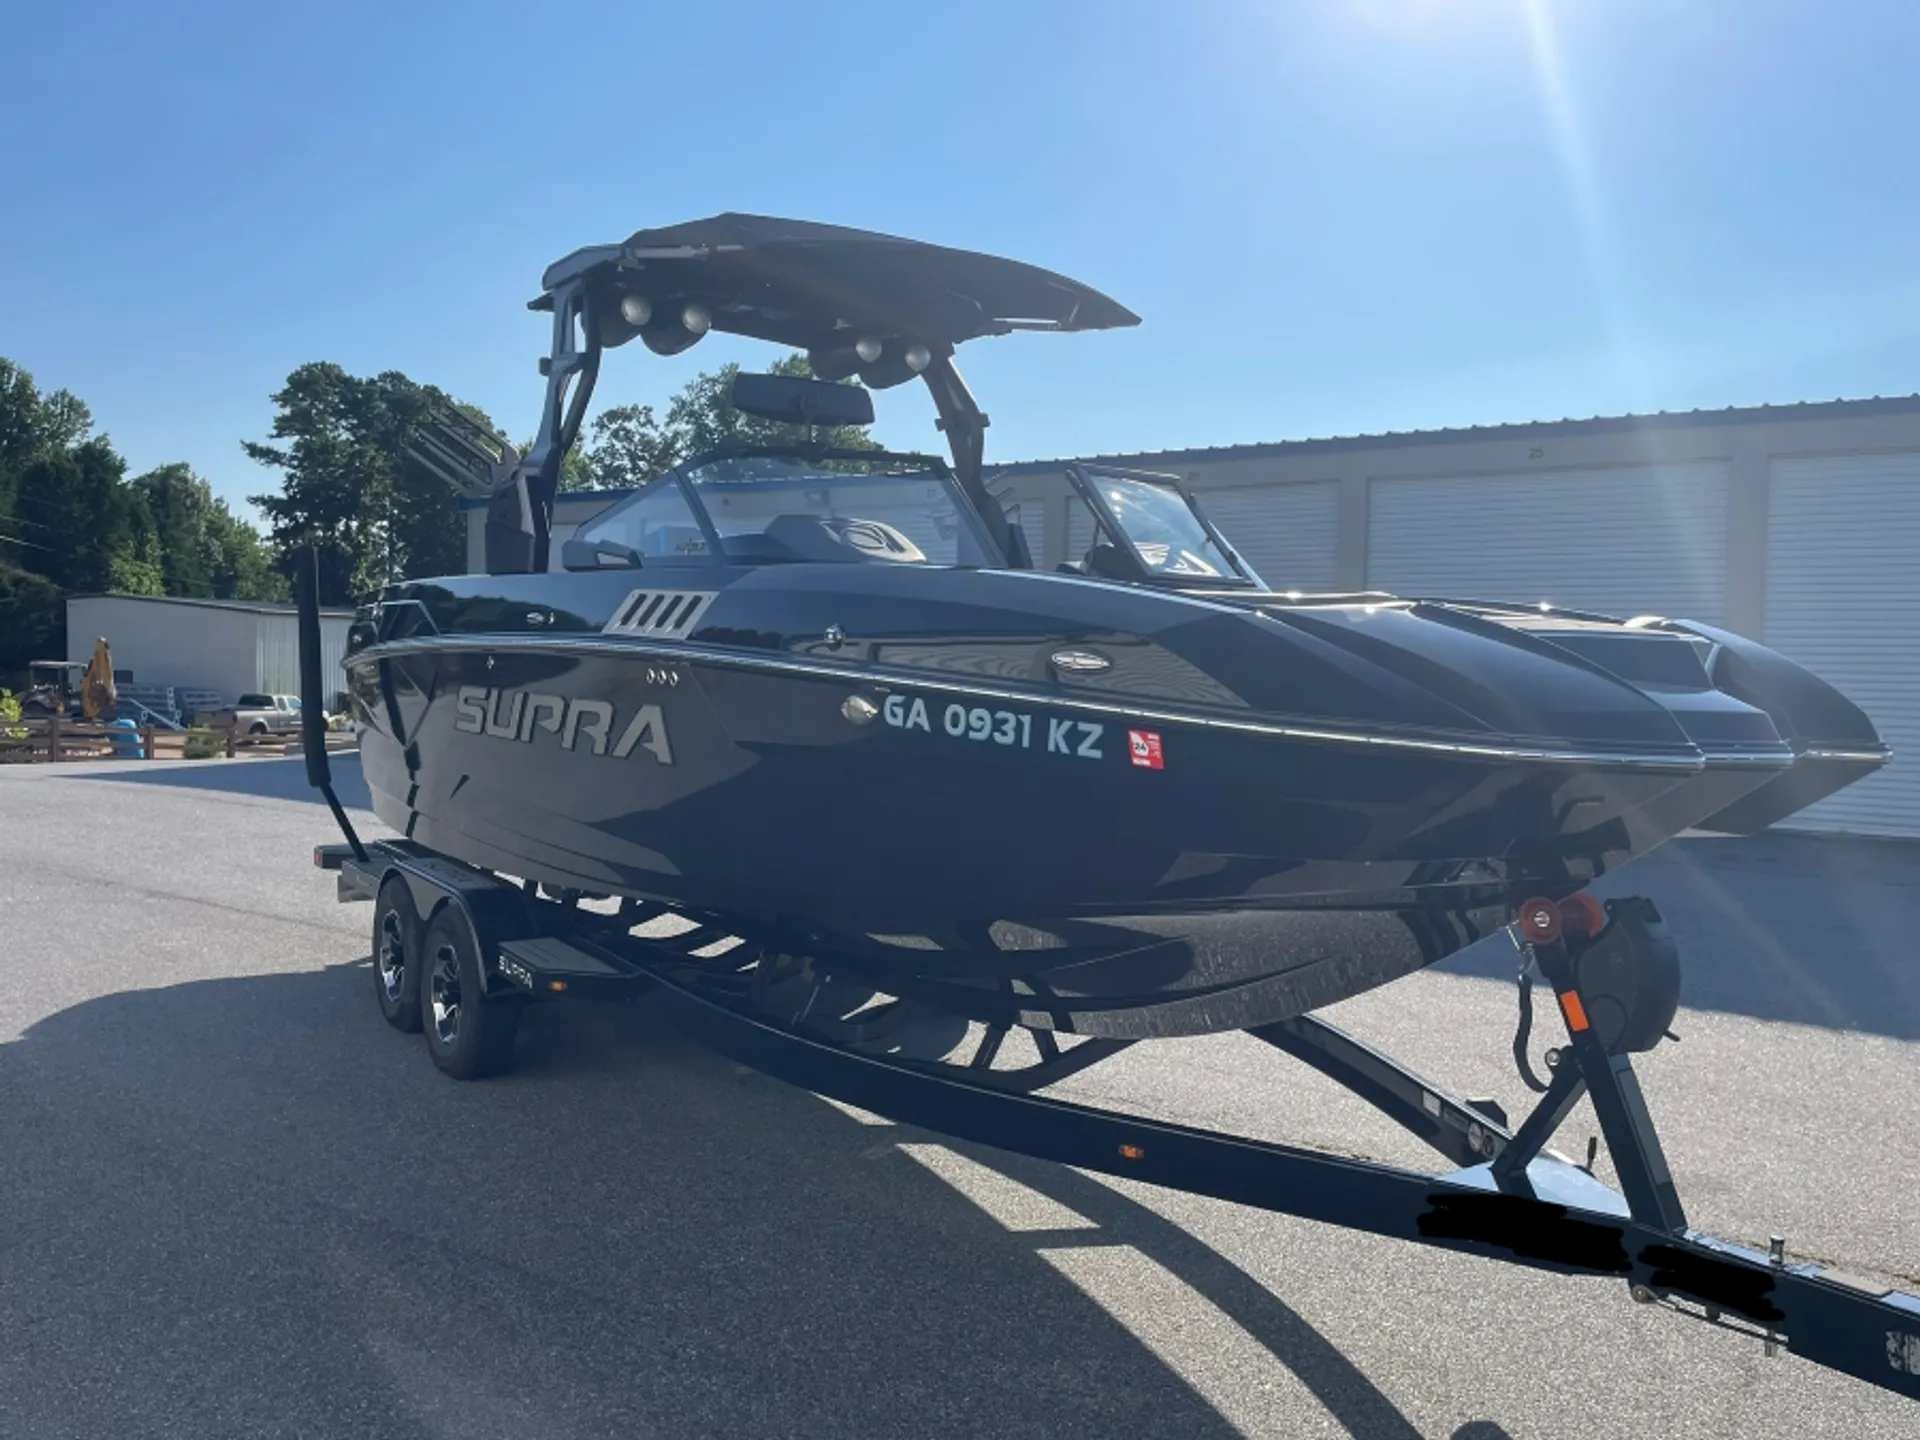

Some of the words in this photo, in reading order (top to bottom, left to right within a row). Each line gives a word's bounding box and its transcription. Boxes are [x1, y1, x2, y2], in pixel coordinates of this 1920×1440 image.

[455, 685, 674, 766] SUPRA
[883, 694, 932, 734] GA
[943, 703, 1032, 749] 0931
[1047, 717, 1104, 759] KZ
